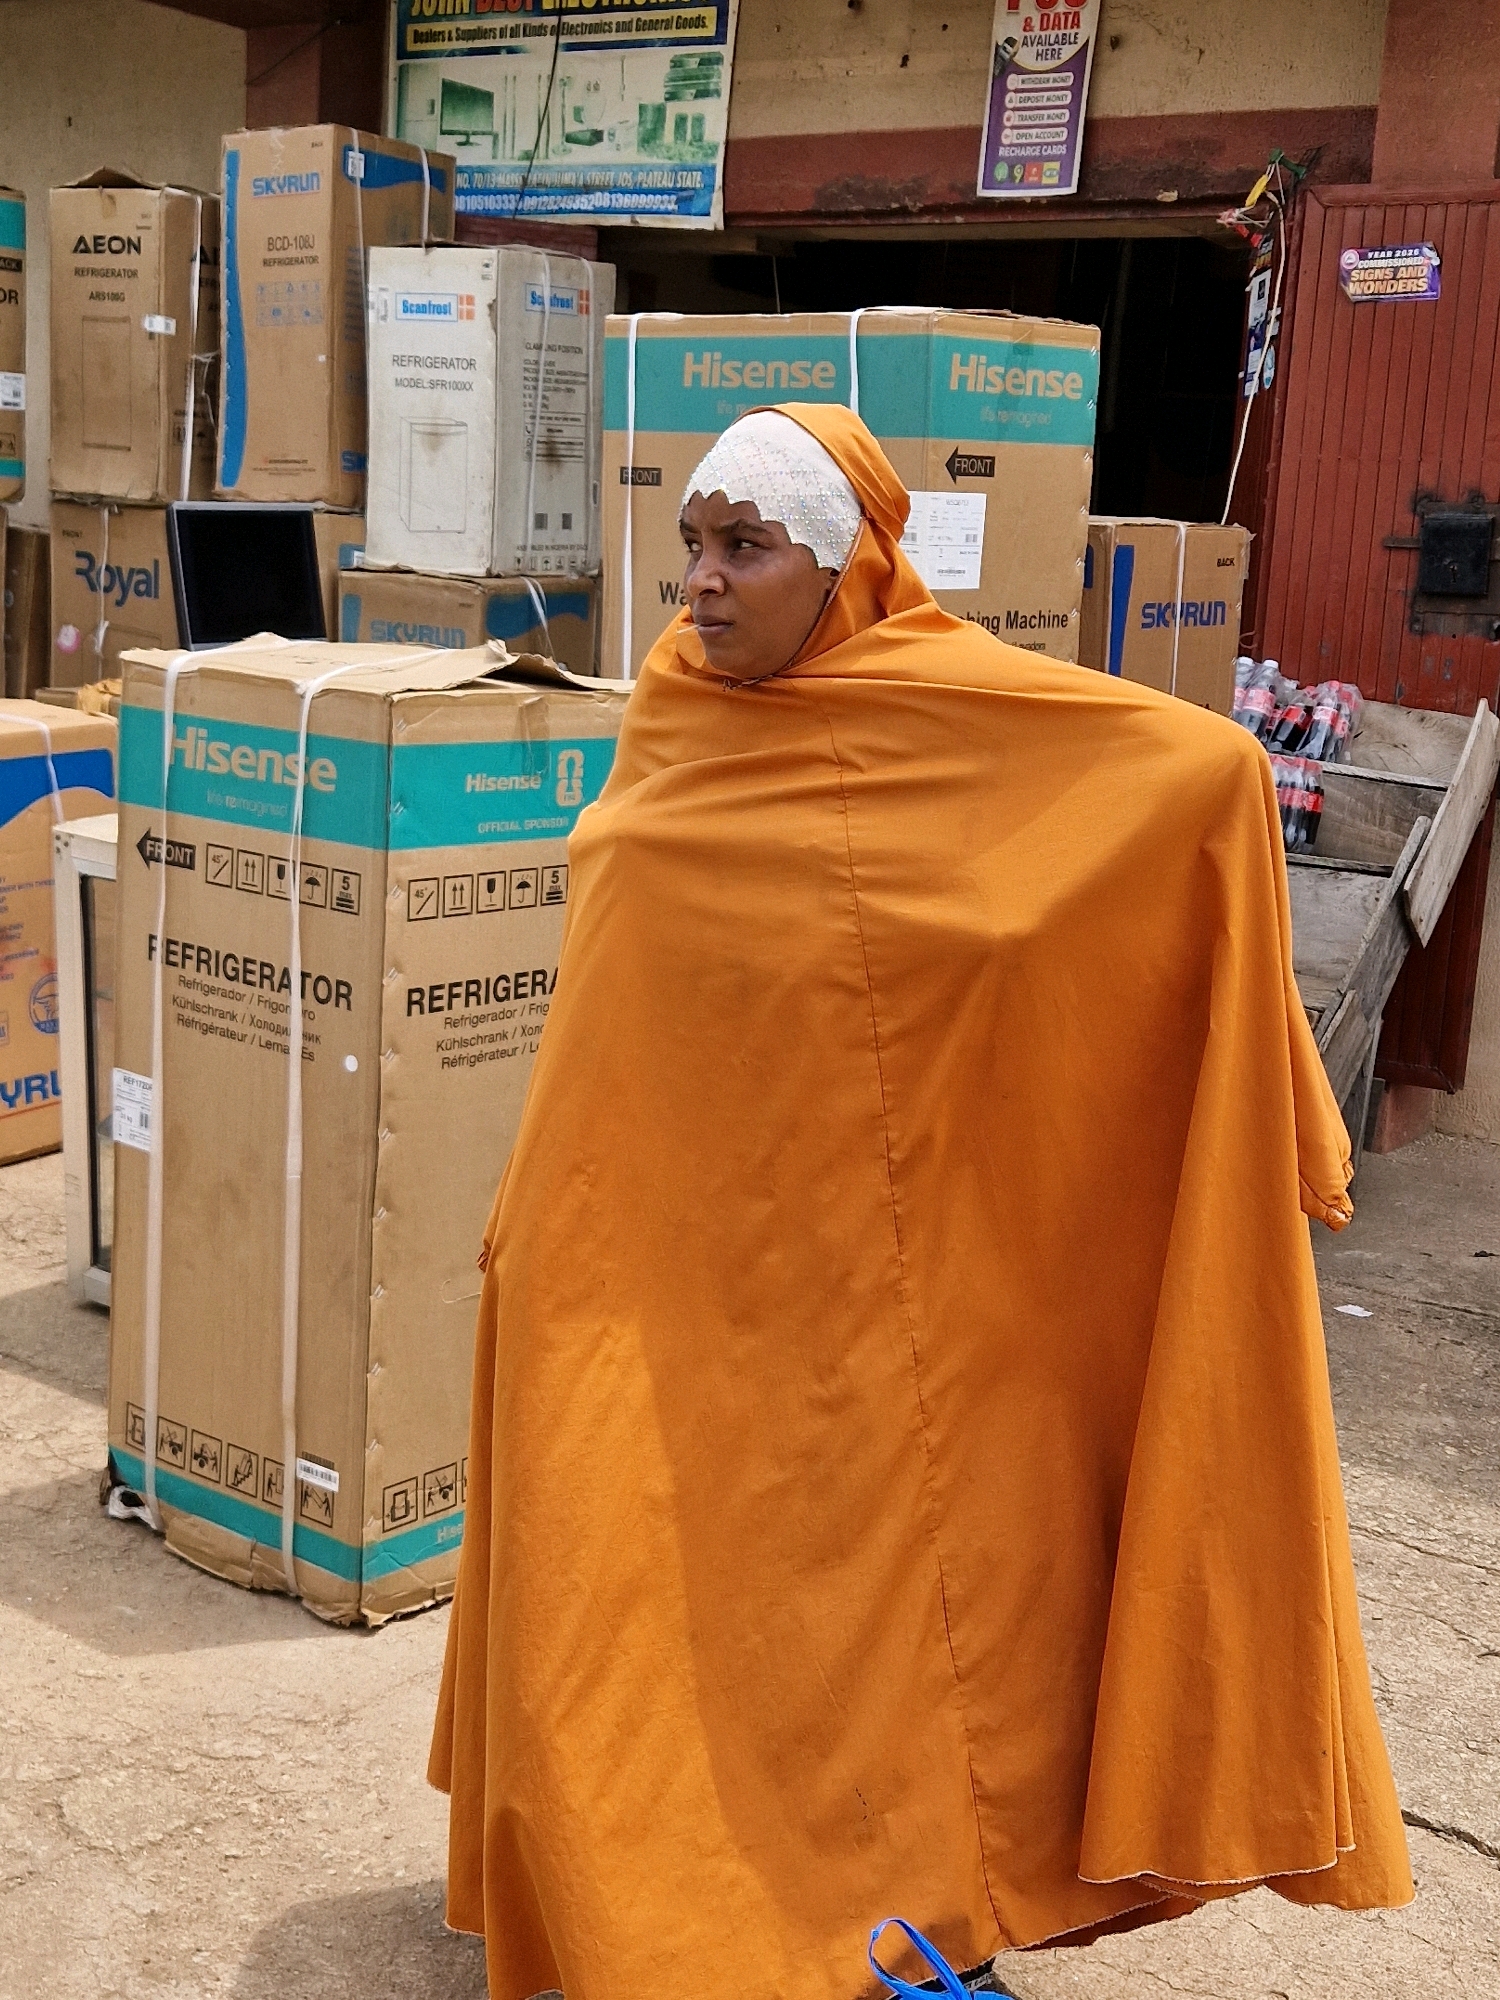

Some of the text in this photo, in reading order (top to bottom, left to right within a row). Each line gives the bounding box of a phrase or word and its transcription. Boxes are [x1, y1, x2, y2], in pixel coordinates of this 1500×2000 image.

[413, 28, 446, 44] Dealers
[455, 26, 497, 42] Suppliers
[499, 24, 508, 39] of
[509, 23, 521, 38] all
[522, 23, 548, 38] Kinds
[561, 20, 613, 36] Electronics
[615, 18, 633, 32] and
[635, 16, 674, 32] General
[676, 14, 708, 30] Goods.
[1022, 11, 1082, 32] & DATA
[1021, 32, 1079, 48] AVAILABLE
[1035, 47, 1063, 62] HERE
[1018, 95, 1045, 104] DEPOSIT
[1017, 113, 1045, 122] TRANSFER
[1015, 130, 1065, 141] OPEN ACCOUNT
[998, 144, 1067, 157] RECHARGE CARDS
[252, 171, 320, 197] SKYRUN
[637, 171, 675, 188] PLATEAU
[72, 234, 142, 255] AEON
[263, 255, 319, 268] REFRIGERATOR
[1358, 257, 1424, 268] COMMISSIONED
[1368, 251, 1393, 259] YEAR
[74, 266, 139, 279] REFRIGERATOR
[1350, 266, 1428, 281] SIGNS AND
[1349, 278, 1428, 295] WONDERS
[402, 298, 452, 316] Scanfrost
[530, 290, 574, 310] Scfrost
[392, 354, 477, 371] REFRIGERATOR
[683, 351, 837, 389] Hisense
[950, 353, 1084, 400] Hisense
[954, 458, 993, 474] FRONT
[75, 550, 160, 607] Royal
[1006, 609, 1068, 630] Machine
[1141, 601, 1226, 629] SKYRUN
[370, 619, 466, 650] SKYRUN
[169, 723, 338, 792] Hisense
[465, 773, 542, 793] Hisense
[478, 817, 569, 834] OFFICIAL SPONSOR
[146, 839, 194, 866] FRONT
[342, 875, 350, 891] 5
[551, 870, 560, 884] 5
[178, 974, 247, 1003] Refrigerador
[171, 994, 239, 1024] Kühlschrank
[444, 1006, 518, 1029] Refrigerador
[177, 1013, 249, 1044] Réfrigérateur
[301, 1046, 315, 1062] Es
[436, 1030, 508, 1053] Kühlschrank
[441, 1045, 520, 1070] Réfrigérateur
